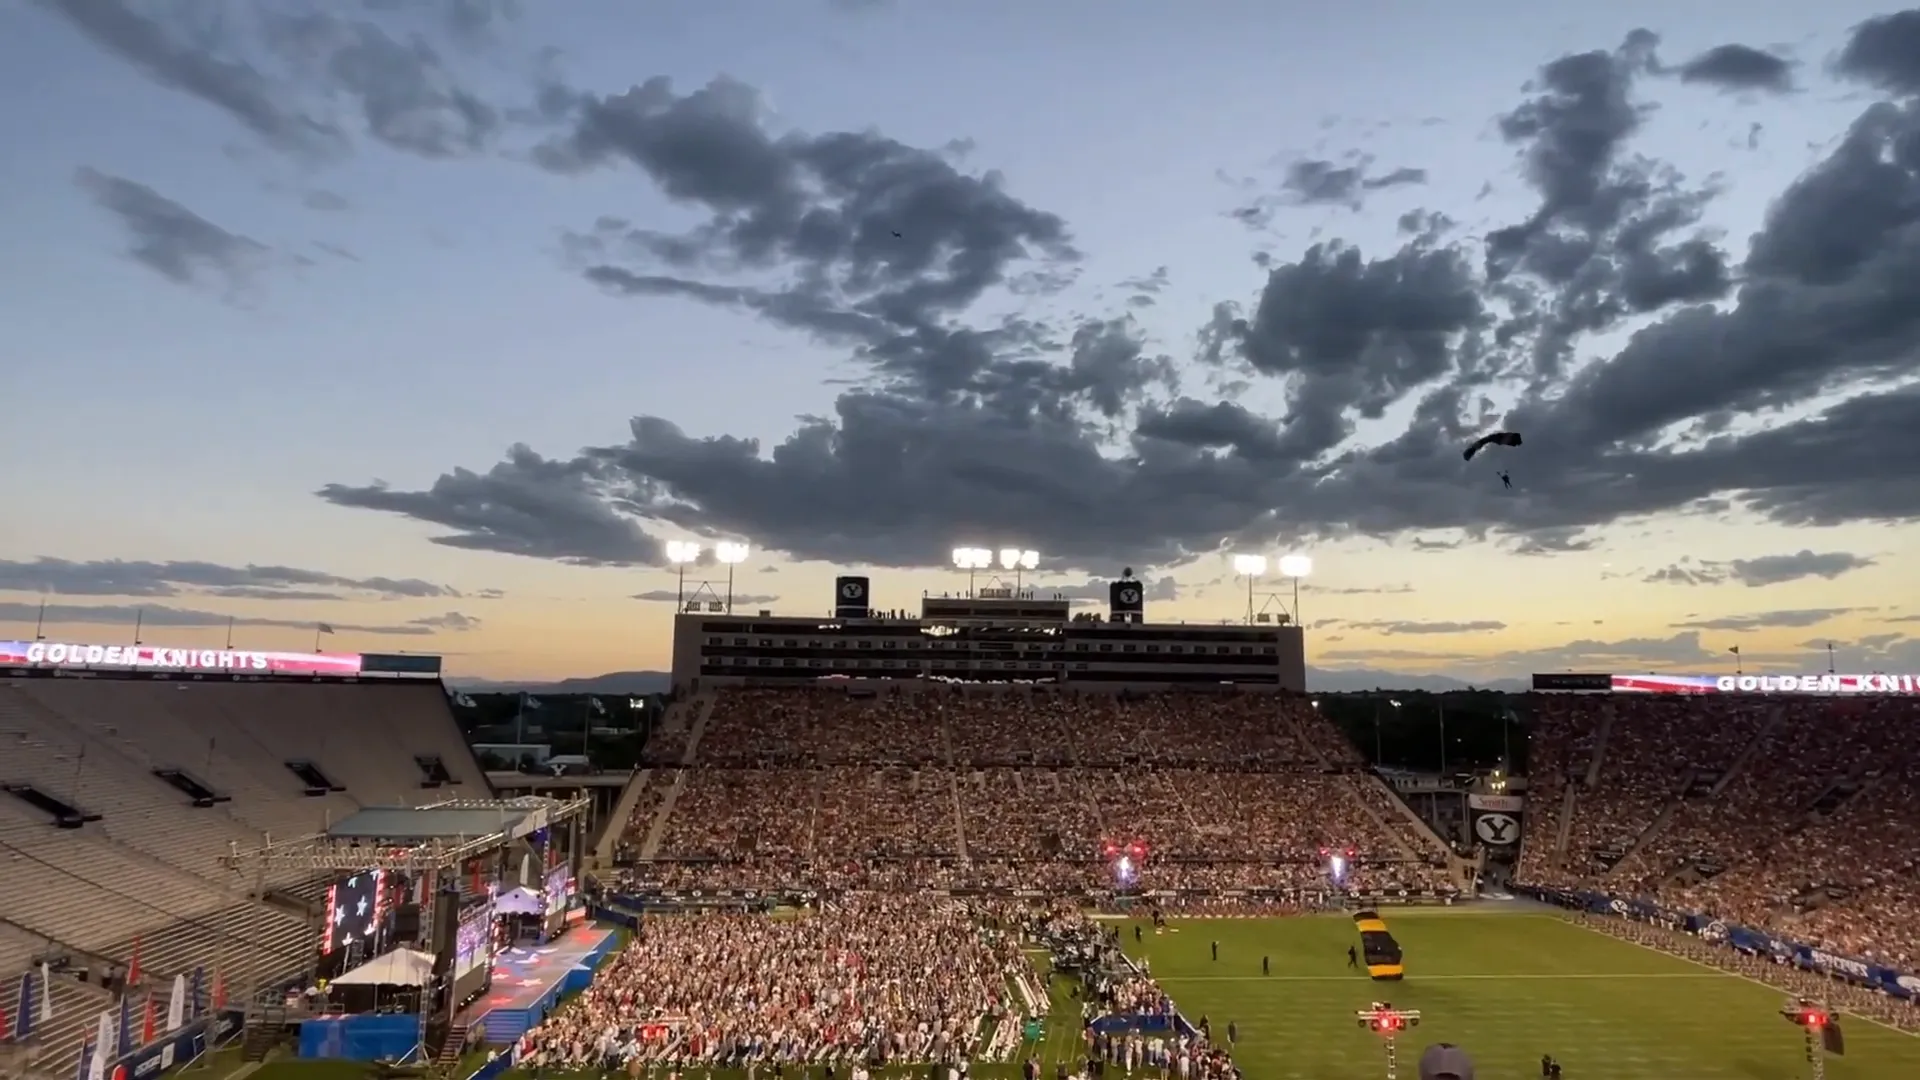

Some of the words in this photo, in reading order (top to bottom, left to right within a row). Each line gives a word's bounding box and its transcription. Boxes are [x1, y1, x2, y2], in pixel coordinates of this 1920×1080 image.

[27, 642, 140, 665] GOLDEN
[151, 647, 268, 669] KNIGHTS
[1716, 674, 1841, 692] GOLDEN
[1855, 674, 1920, 693] KNI
[1481, 816, 1514, 841] Y
